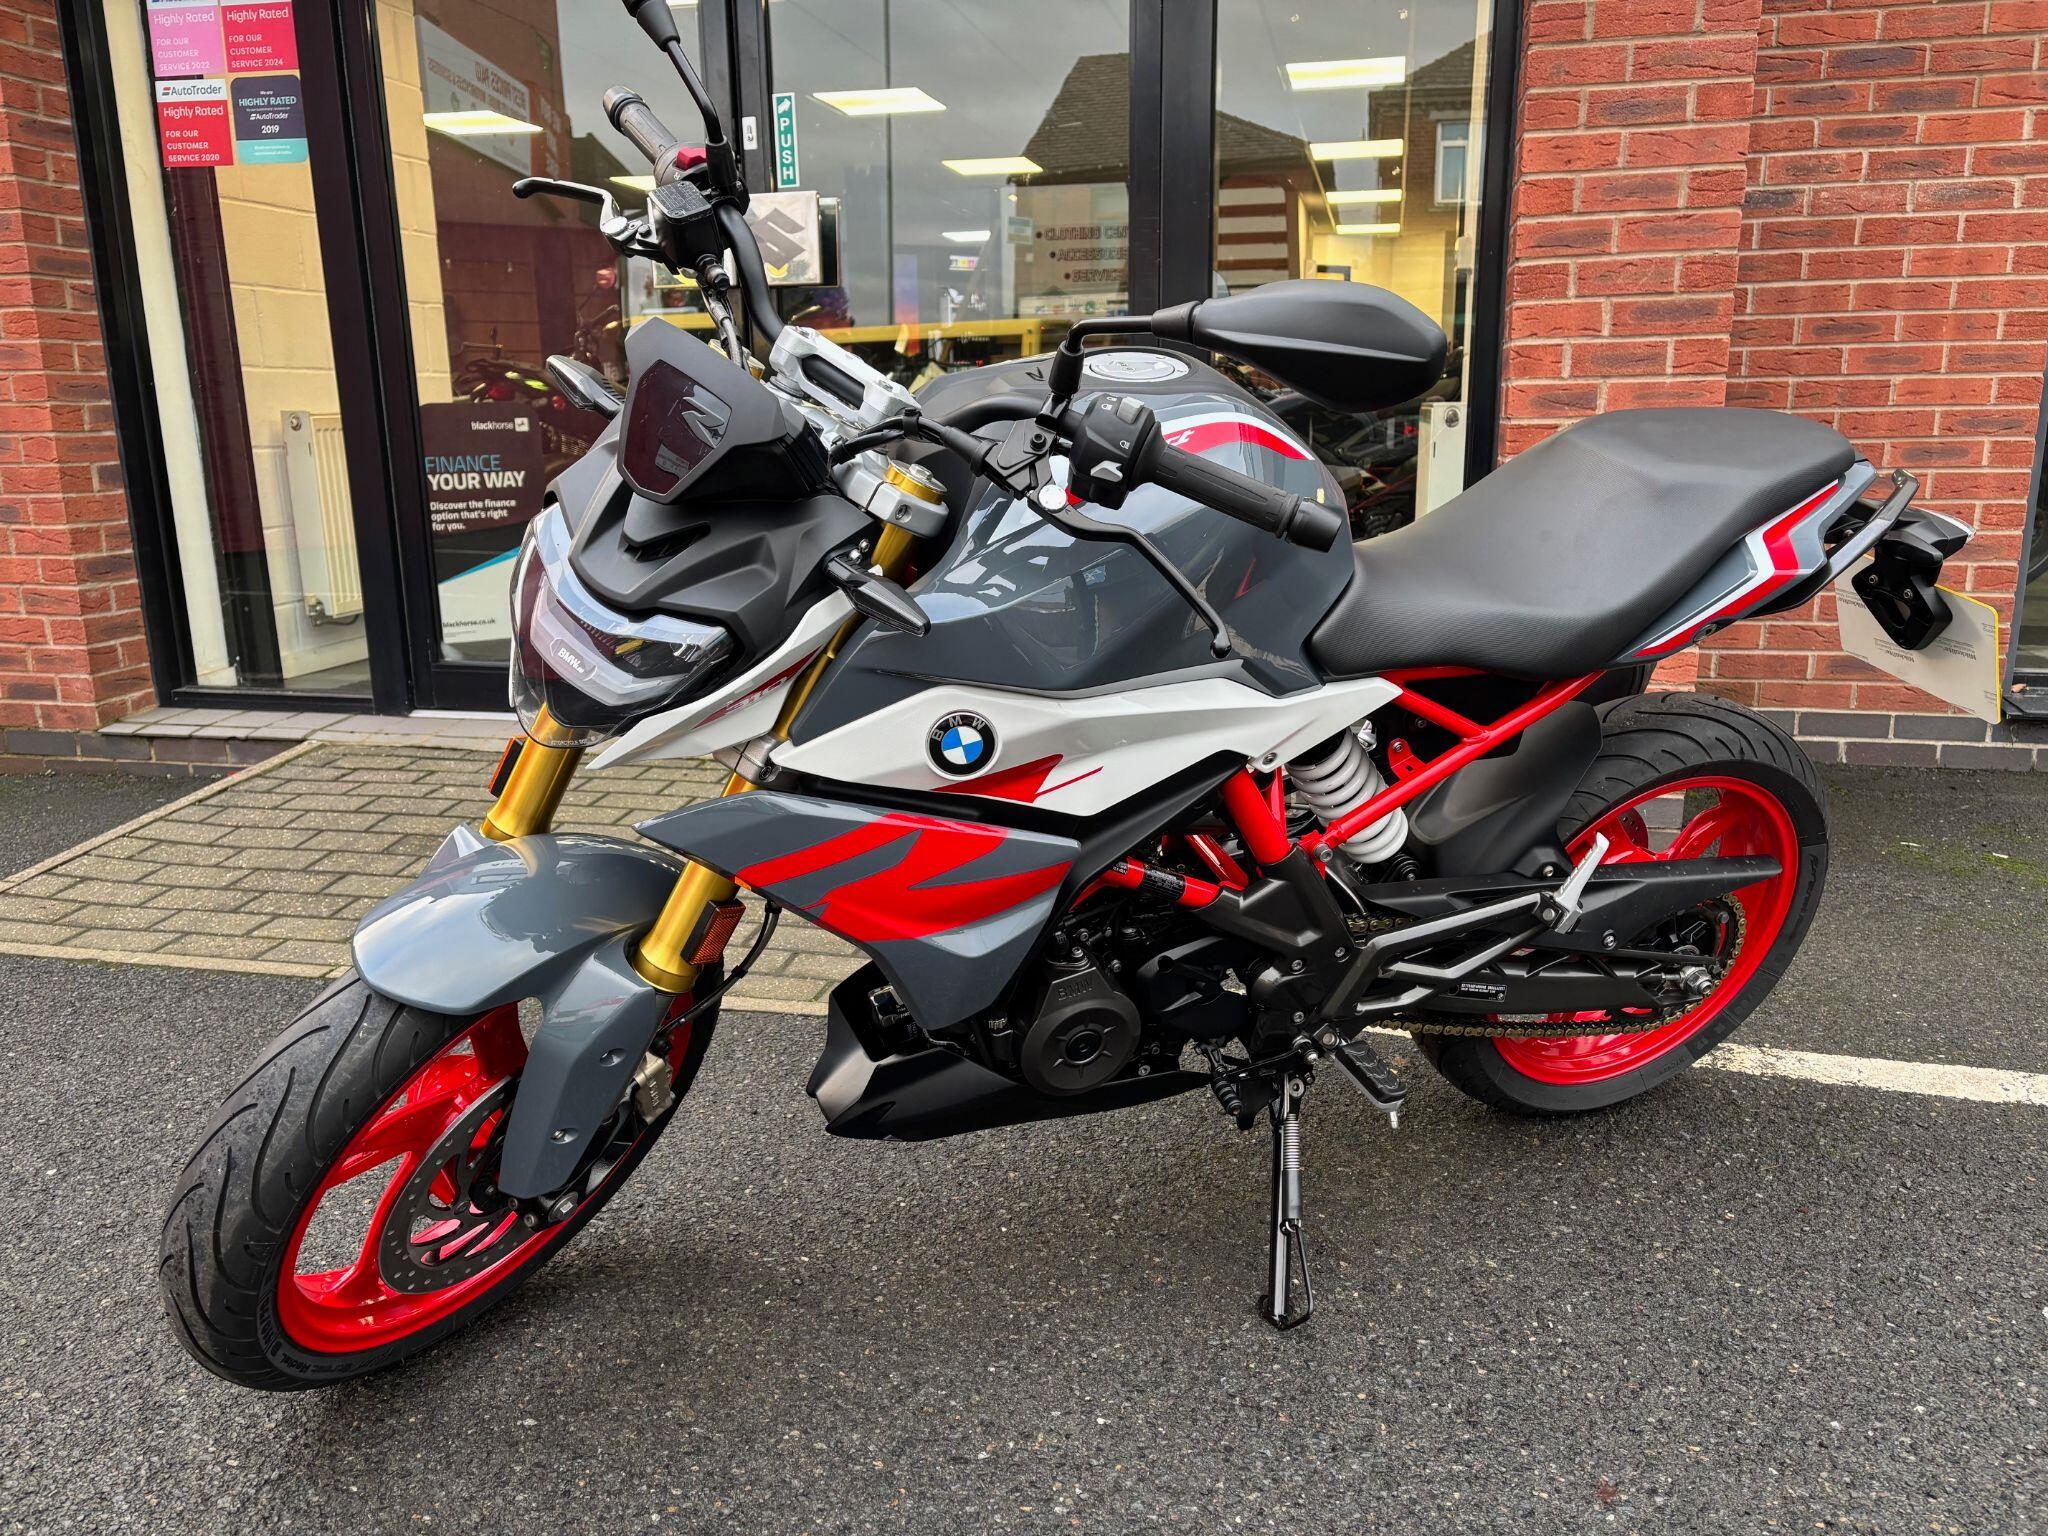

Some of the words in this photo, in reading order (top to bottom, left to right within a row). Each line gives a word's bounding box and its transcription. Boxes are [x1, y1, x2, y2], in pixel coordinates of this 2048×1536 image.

[154, 12, 185, 27] Highly
[186, 11, 215, 23] Rated
[226, 10, 258, 24] Highly
[259, 7, 290, 20] Rated
[156, 38, 171, 46] FOR
[173, 37, 189, 45] OUR
[228, 35, 245, 43] FOR
[246, 33, 262, 42] OUR
[158, 49, 199, 58] CUSTOMER
[230, 46, 273, 56] CUSTOMER
[160, 62, 190, 71] SERVICE
[191, 61, 210, 70] 2022
[231, 59, 263, 68] SERVICE
[264, 58, 284, 67] 2024
[170, 84, 222, 97] AutoTrader
[238, 97, 269, 107] HIGHLY
[270, 96, 297, 106] RATED
[163, 106, 194, 120] Highly
[195, 105, 224, 117] Rated
[255, 112, 289, 121] AutoTrader
[165, 130, 181, 138] FOR
[182, 129, 199, 138] OUR
[261, 124, 280, 134] 2019
[167, 141, 209, 150] CUSTOMER
[779, 117, 794, 180] PUSH
[168, 154, 200, 162] SERVICE
[201, 153, 220, 161] 2020
[471, 421, 514, 431] blackhorse
[424, 454, 501, 473] FINANCE
[427, 472, 480, 491] YOUR
[483, 470, 526, 489] WAY
[430, 500, 467, 511] Discover
[468, 499, 484, 509] the
[484, 499, 517, 508] finance
[431, 511, 459, 522] option
[460, 510, 486, 520] that's
[487, 509, 508, 520] right
[432, 522, 445, 531] for
[447, 523, 466, 532] you.
[558, 647, 581, 668] BMW
[931, 714, 986, 742] BMW
[1057, 976, 1093, 1001] BMW
